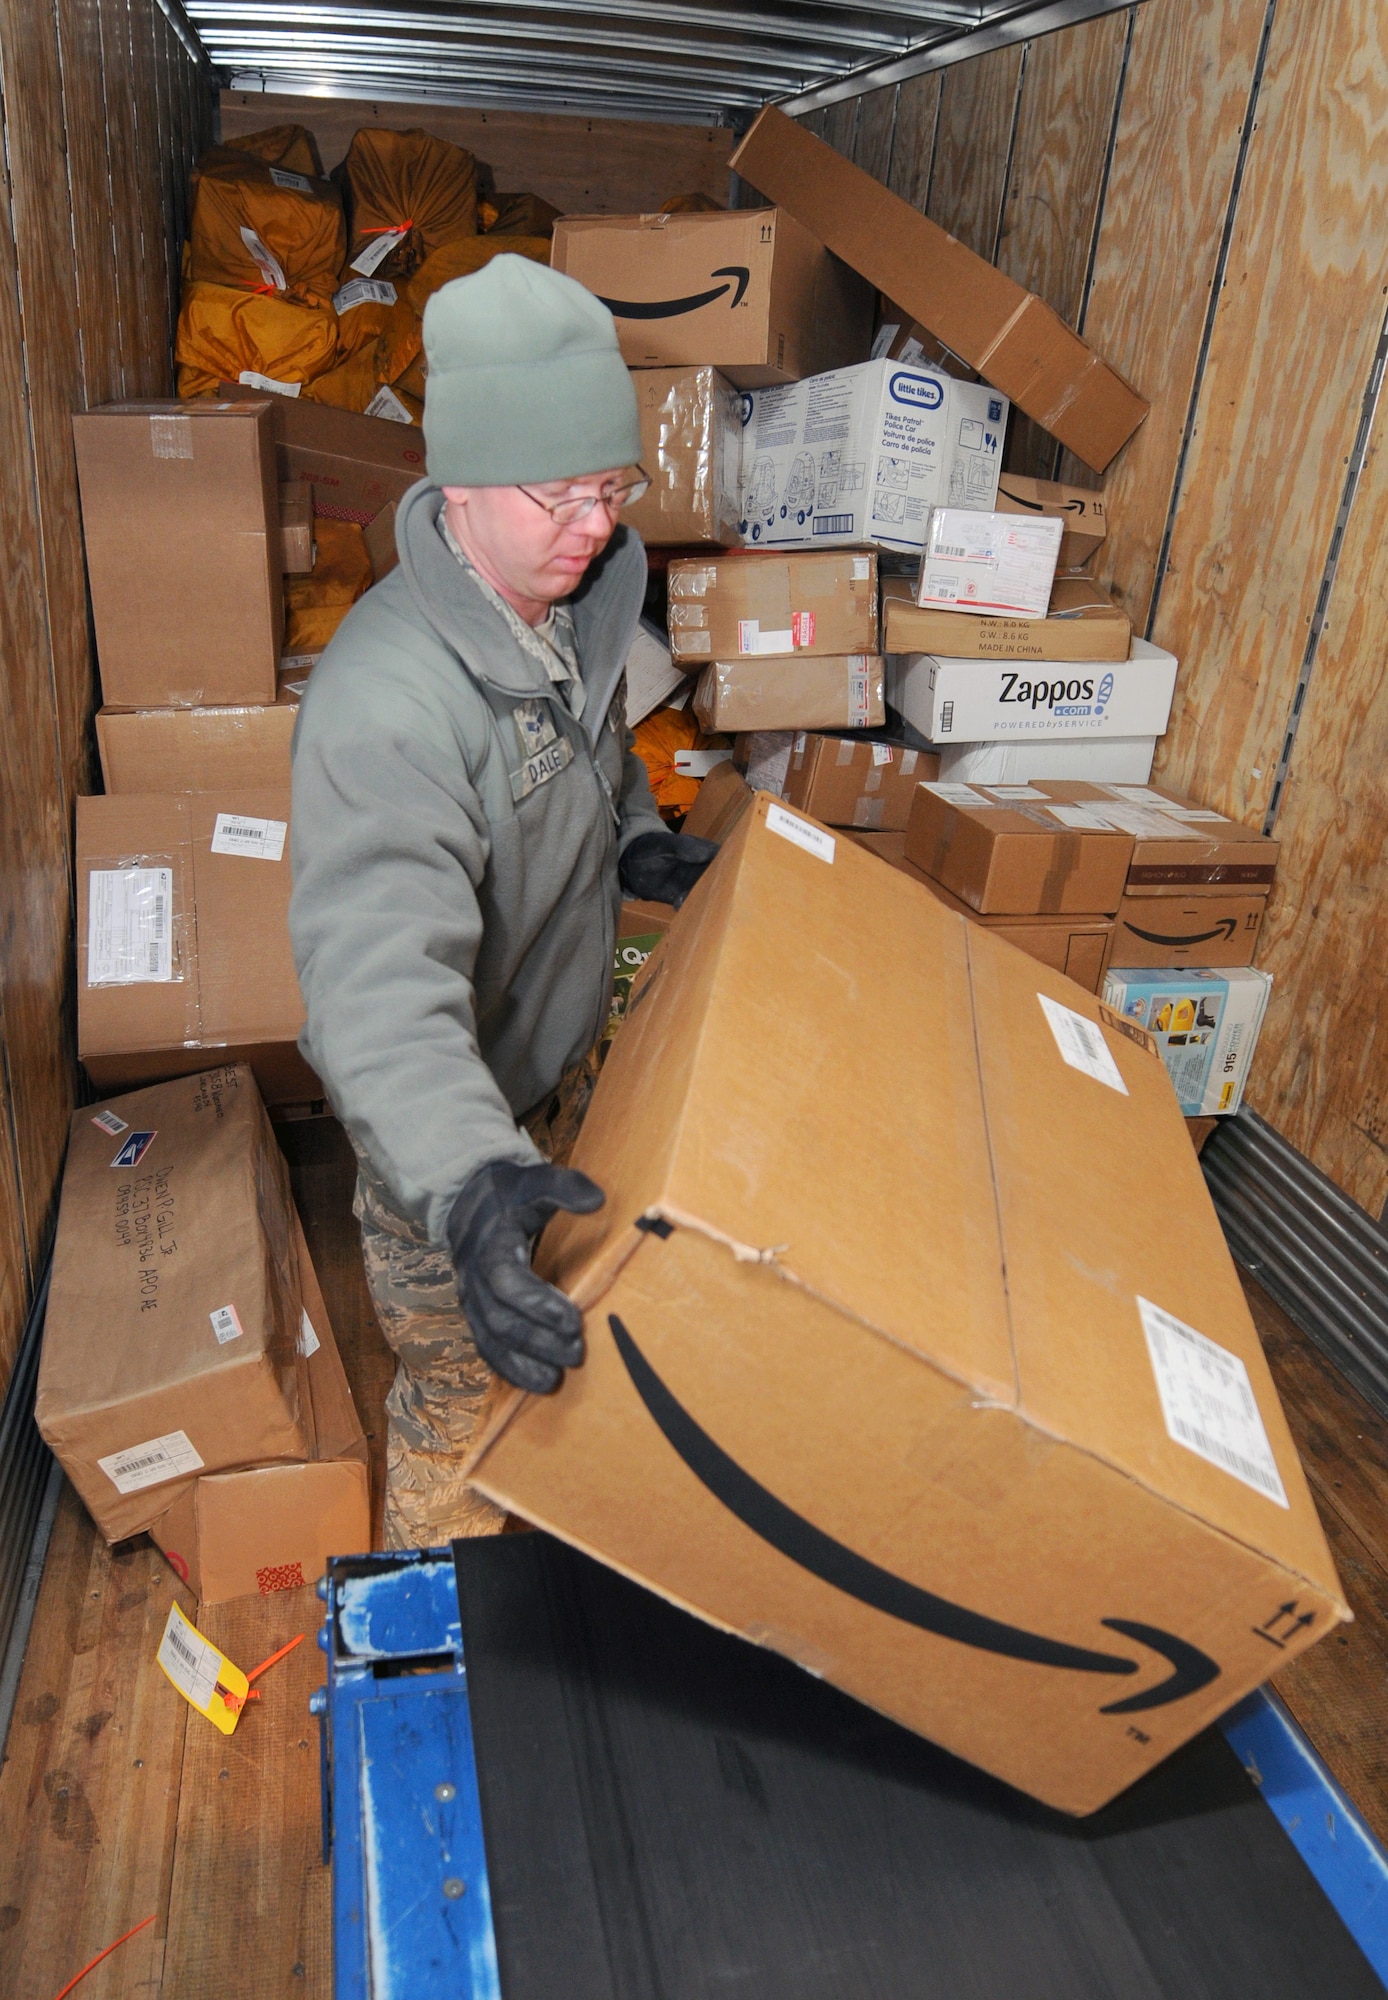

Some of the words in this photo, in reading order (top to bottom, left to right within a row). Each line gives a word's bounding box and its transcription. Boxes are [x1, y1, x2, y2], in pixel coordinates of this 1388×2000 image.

[898, 382, 916, 395] little
[884, 420, 903, 430] Police
[886, 412, 901, 422] Tikes
[883, 430, 906, 440] Voiture
[917, 438, 935, 447] police
[882, 440, 899, 448] Carro
[911, 446, 931, 455] policía
[1003, 632, 1015, 640] 8.6
[978, 643, 1003, 652] MADE
[999, 674, 1094, 709] Zappos
[529, 749, 561, 784] DALE
[1224, 1053, 1237, 1073] 915
[156, 1166, 174, 1200] OWEN
[132, 1197, 150, 1214] 37
[115, 1220, 131, 1247] 0049
[138, 1269, 159, 1295] APO
[140, 1298, 158, 1312] AE
